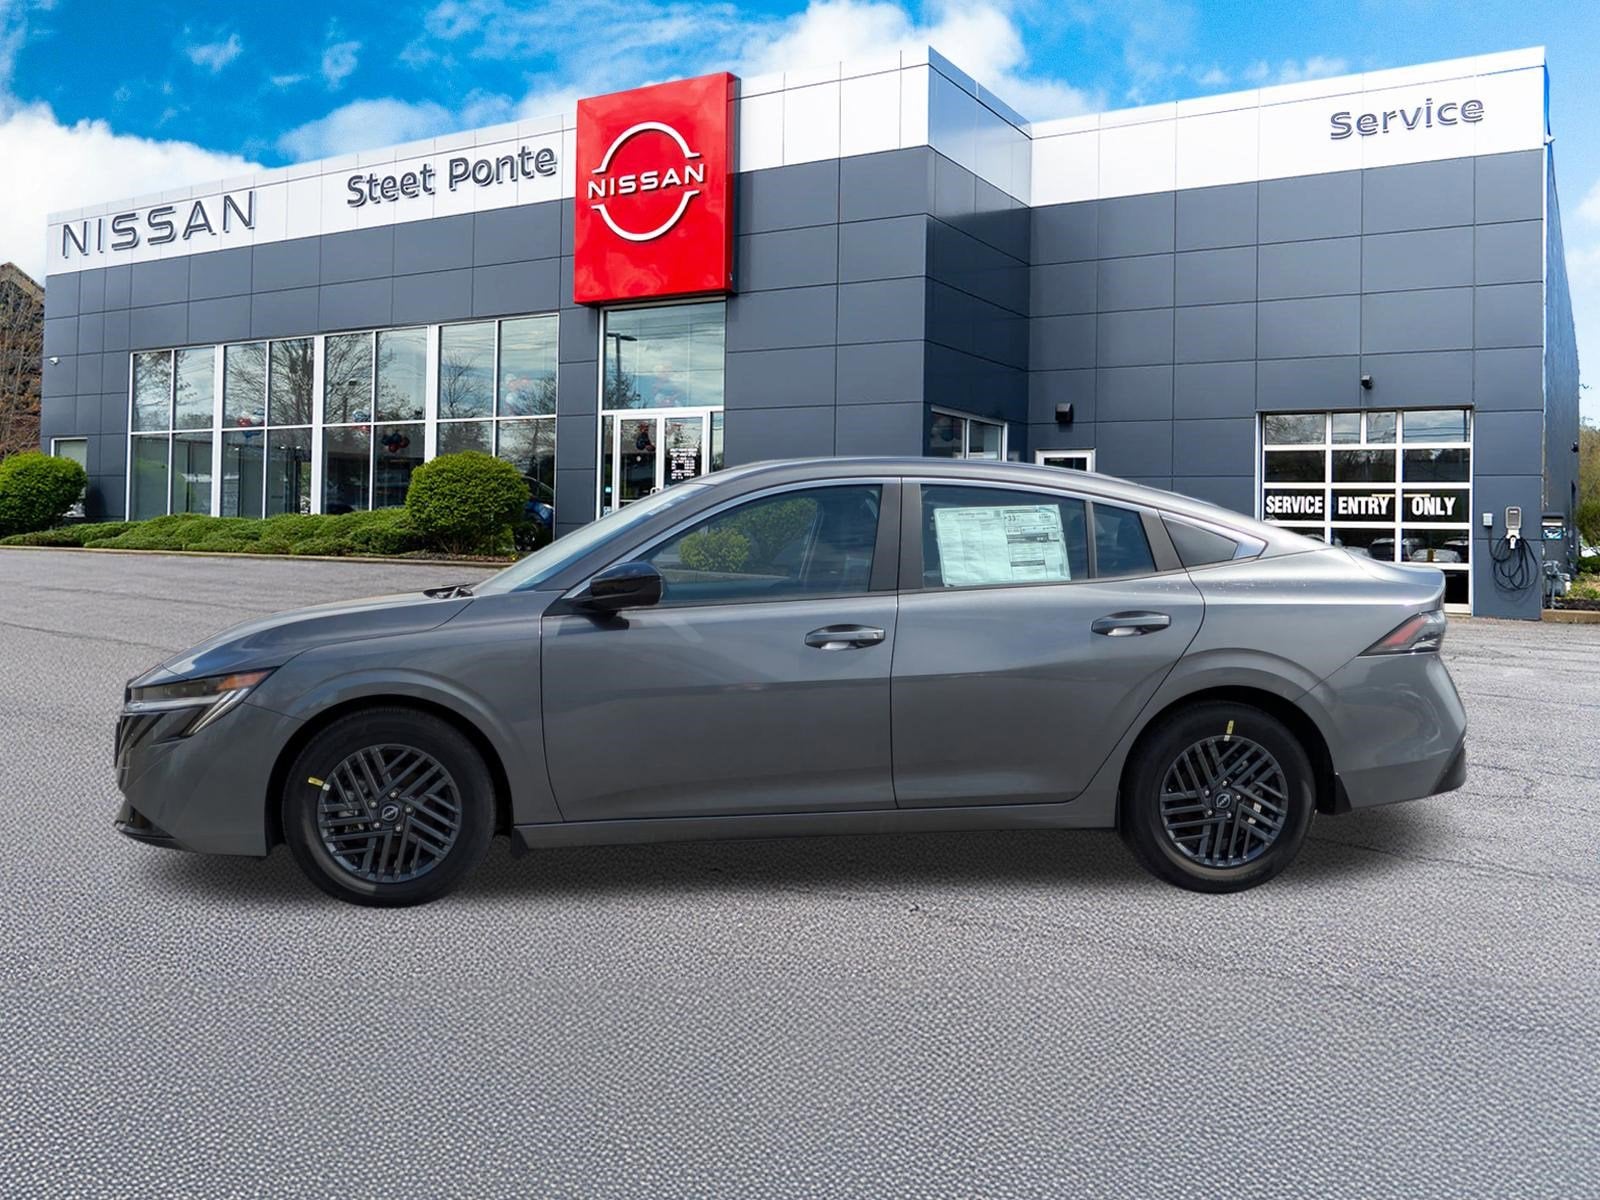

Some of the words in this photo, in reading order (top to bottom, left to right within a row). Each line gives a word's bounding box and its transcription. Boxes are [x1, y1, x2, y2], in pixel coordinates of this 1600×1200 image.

[1330, 98, 1484, 140] Service
[347, 163, 435, 207] Steet
[449, 146, 557, 191] Ponte
[587, 163, 704, 199] NISSAN
[62, 190, 254, 259] NISSAN
[1266, 495, 1323, 514] SERVICE
[1338, 496, 1389, 515] ENTRY
[1411, 496, 1456, 516] ONLY
